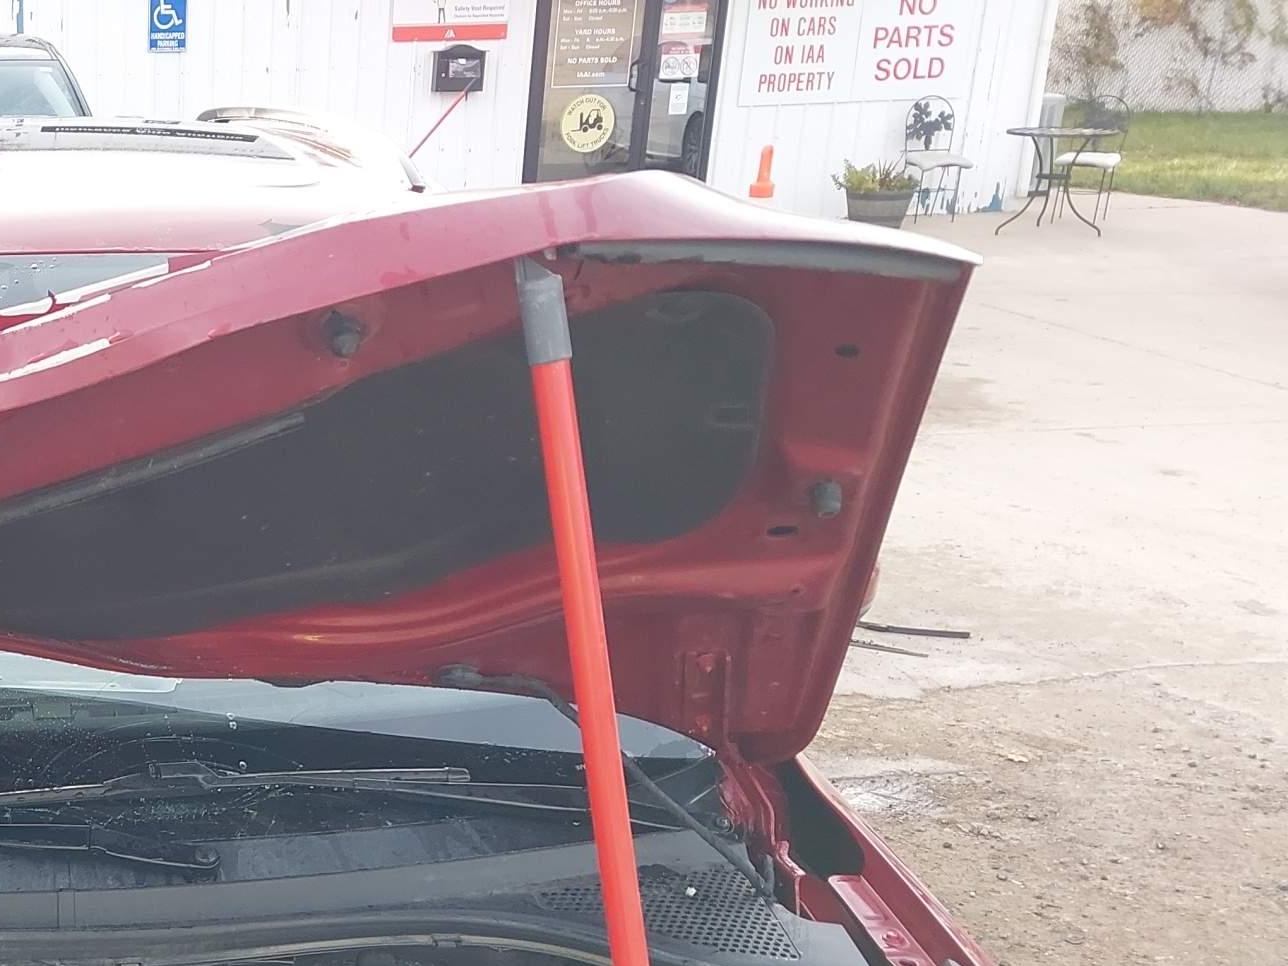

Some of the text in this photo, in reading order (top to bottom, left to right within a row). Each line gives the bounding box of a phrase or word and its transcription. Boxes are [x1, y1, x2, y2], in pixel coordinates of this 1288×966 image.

[899, 0, 937, 15] NO
[770, 16, 837, 37] ON CARS
[873, 24, 955, 49] PARTS
[774, 44, 825, 65] ON IAA
[874, 57, 944, 81] SOLD
[758, 71, 835, 93] PROPERTY
